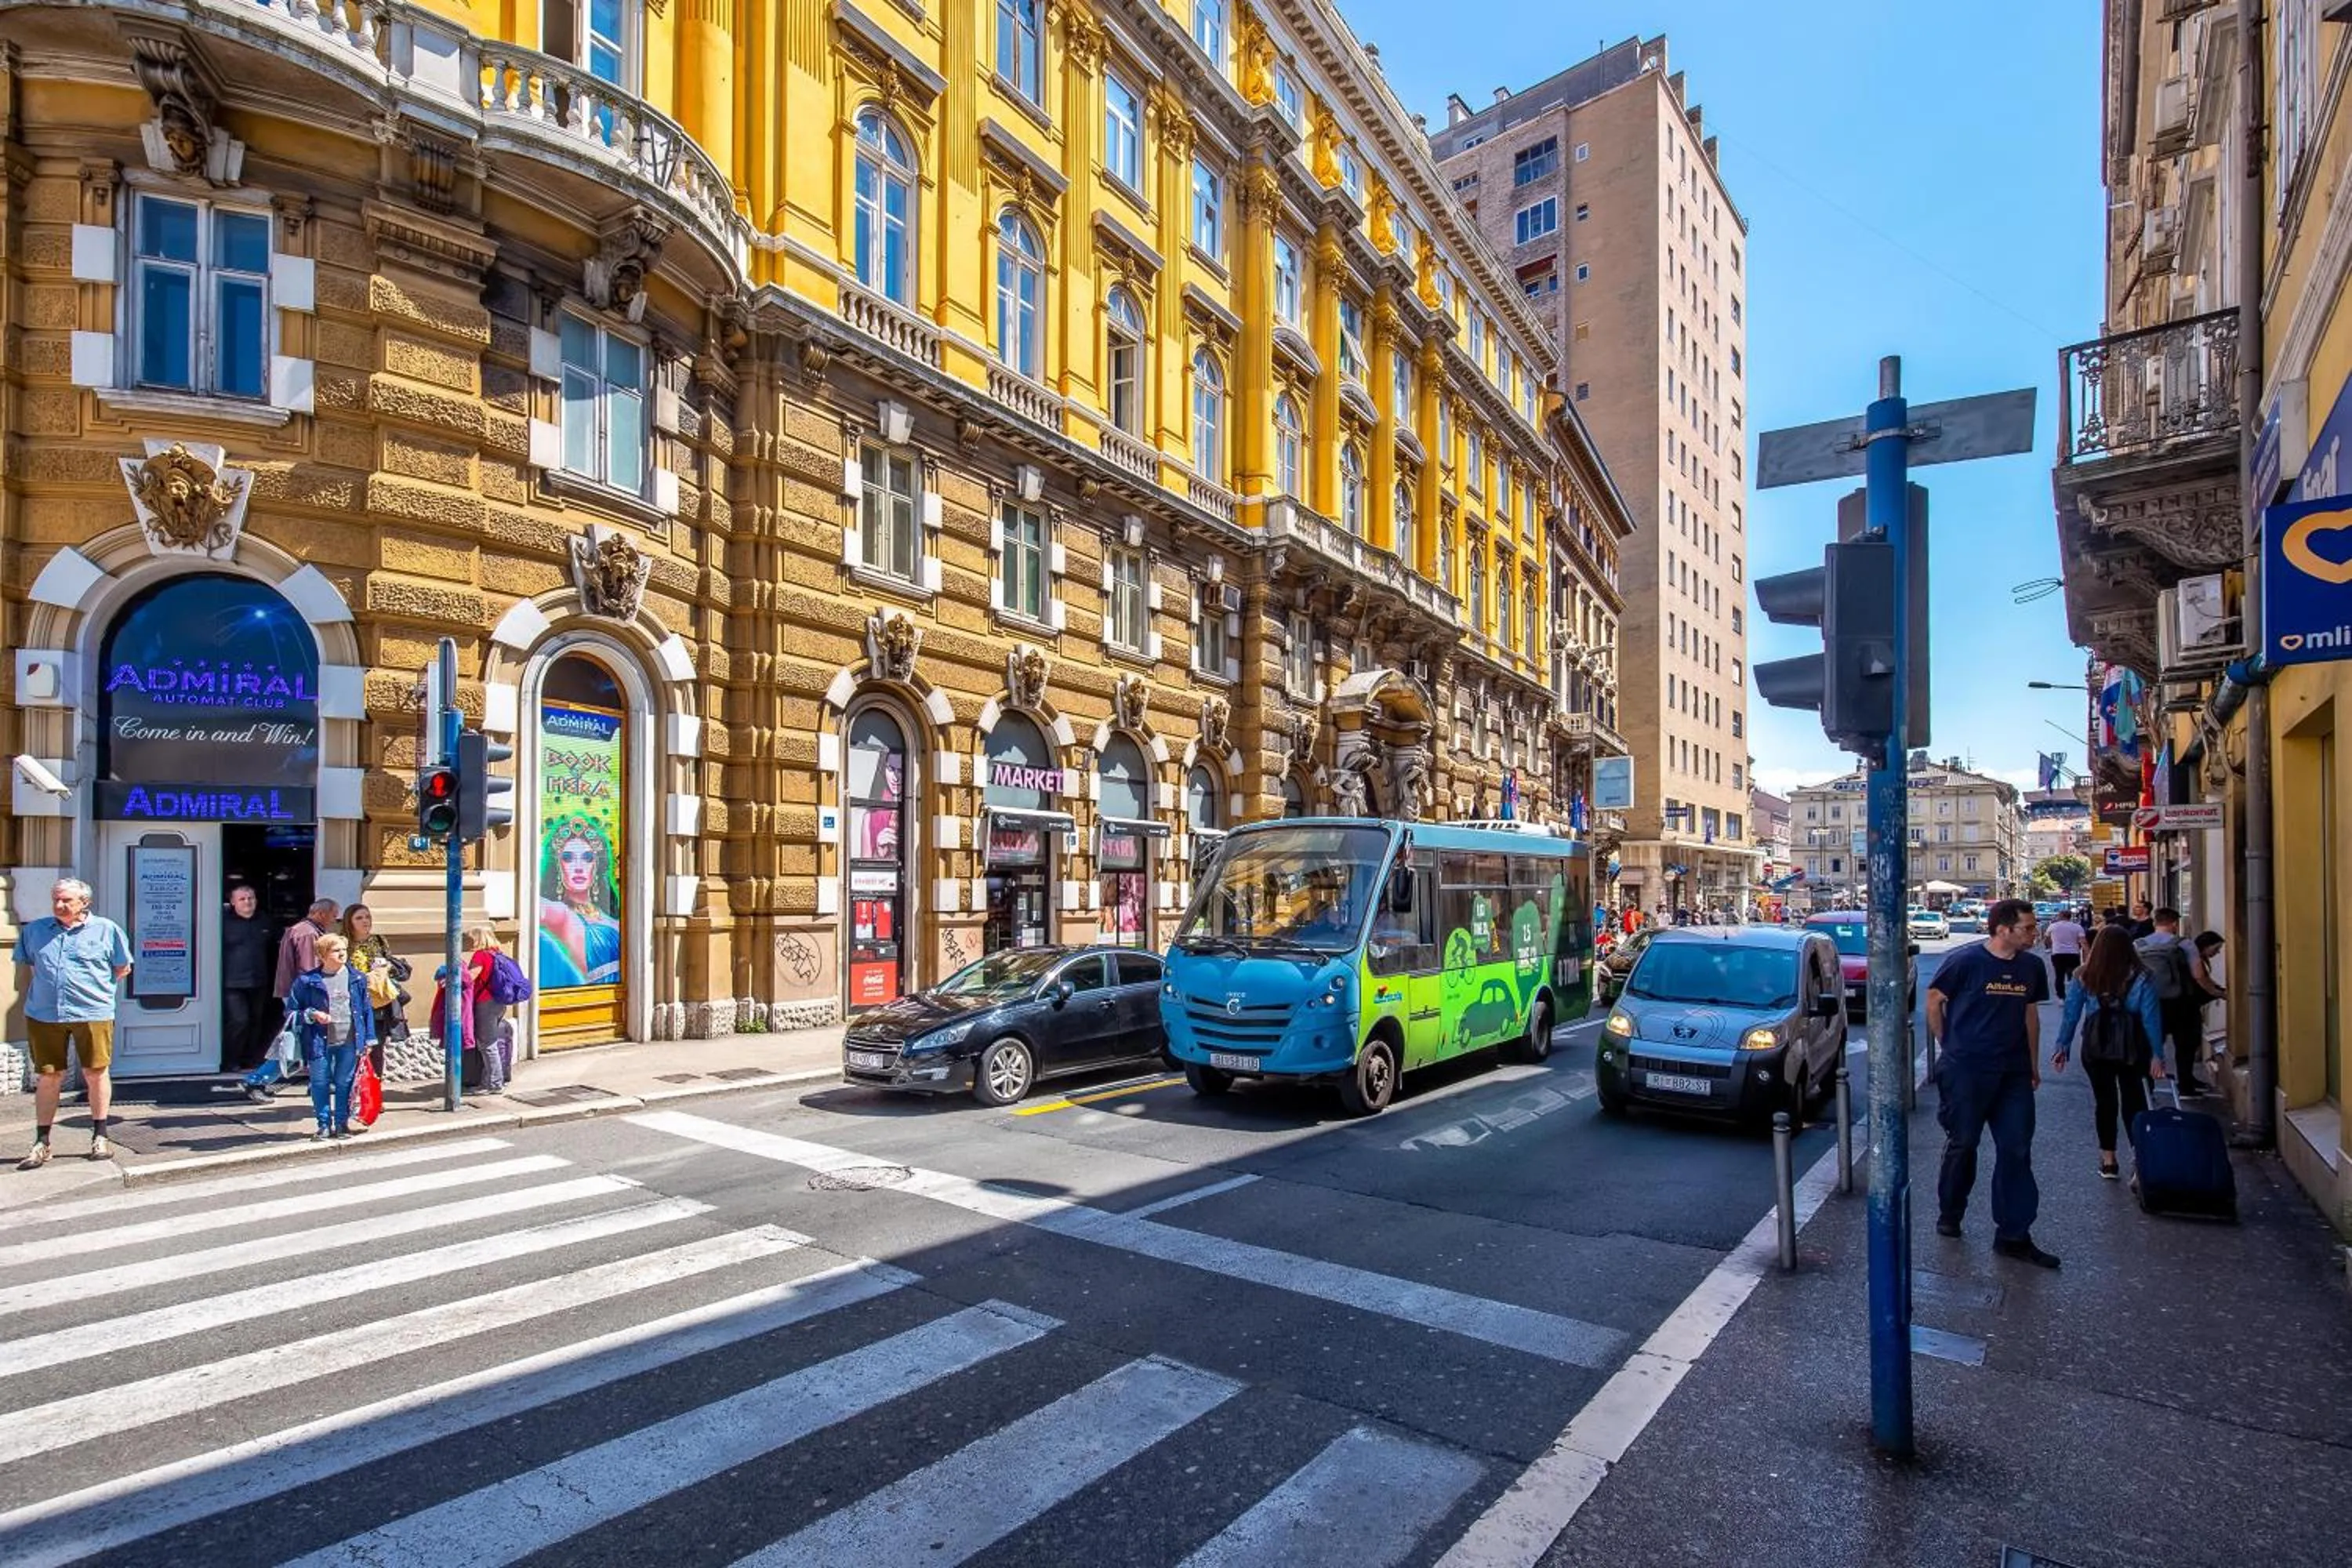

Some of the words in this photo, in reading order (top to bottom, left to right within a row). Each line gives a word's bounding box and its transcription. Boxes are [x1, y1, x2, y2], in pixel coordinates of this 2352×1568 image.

[106, 663, 318, 700] ADMIRAL
[153, 695, 234, 706] AUTOMAT
[244, 696, 286, 709] CLUB
[113, 716, 181, 739] Come
[185, 725, 207, 739] in
[211, 724, 256, 743] and
[258, 722, 314, 746] Win!
[546, 714, 610, 735] ADMIRAL
[545, 747, 612, 773] BOOK
[993, 764, 1065, 793] MARKET
[123, 785, 294, 819] ADMIRAL
